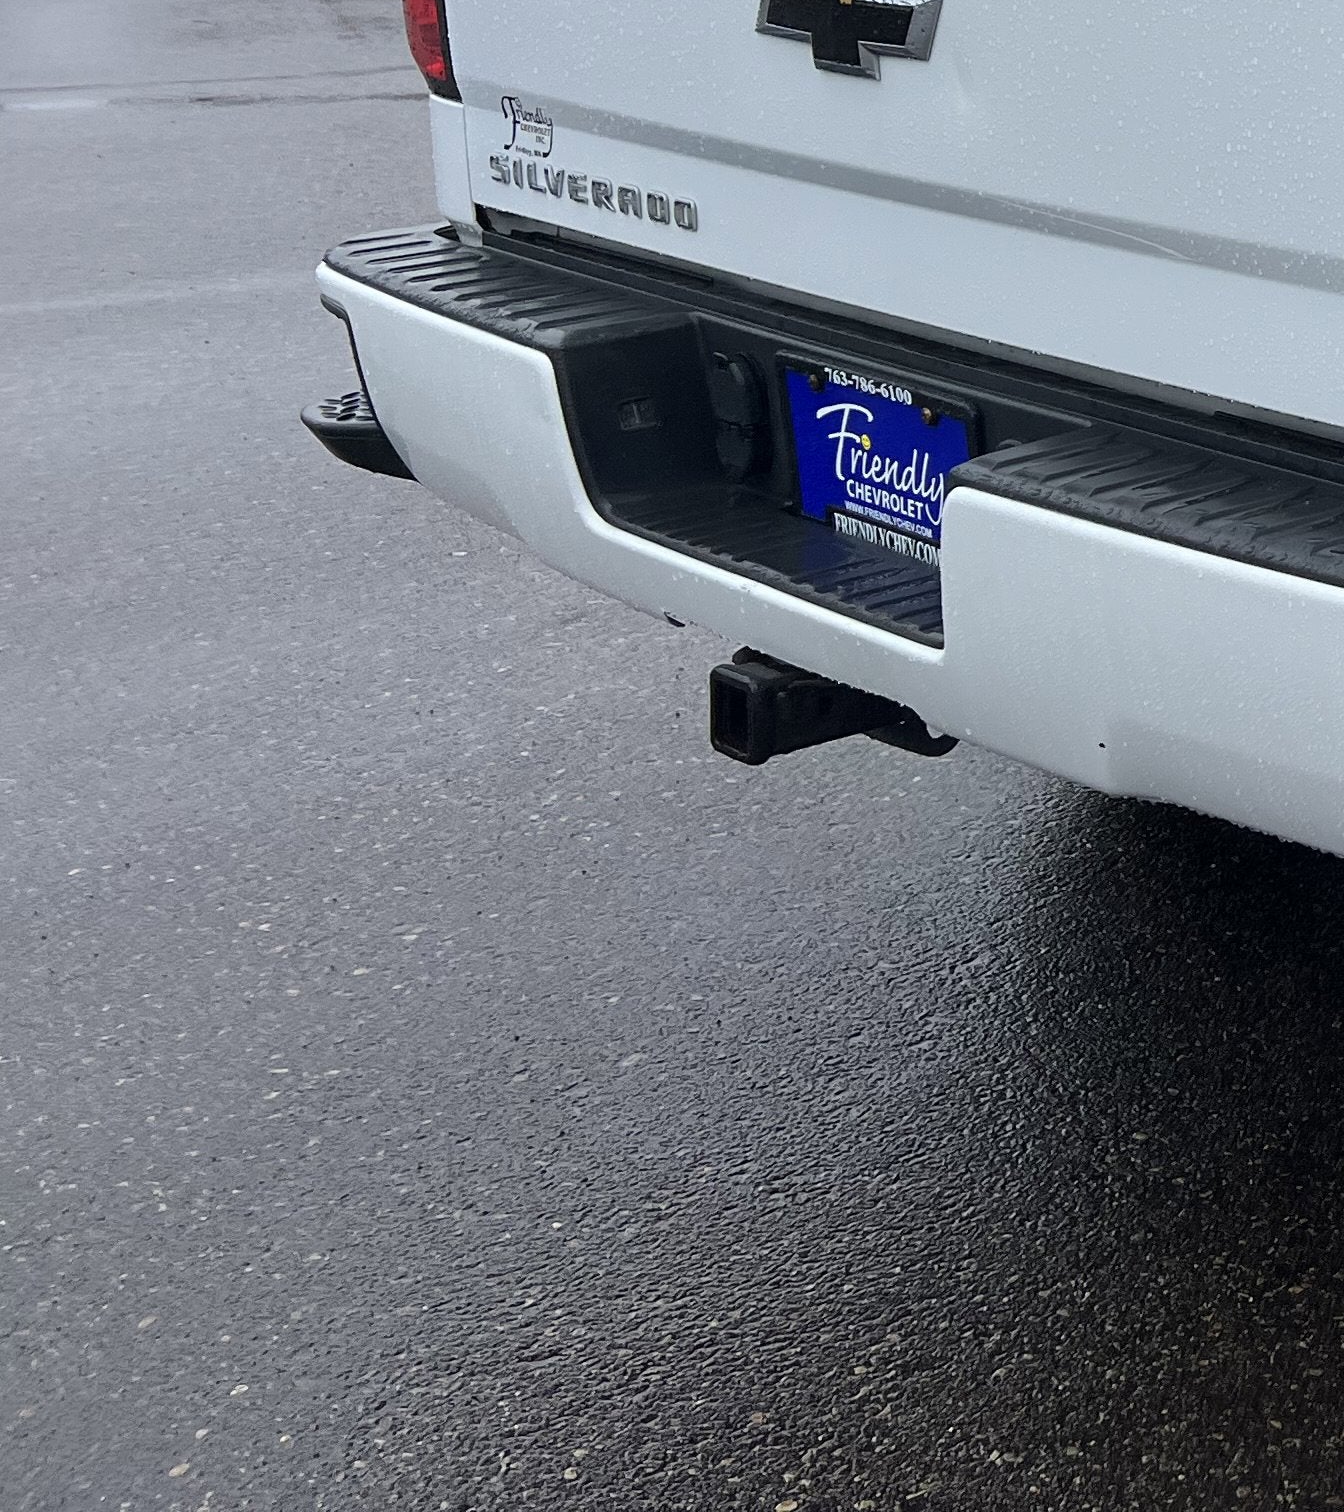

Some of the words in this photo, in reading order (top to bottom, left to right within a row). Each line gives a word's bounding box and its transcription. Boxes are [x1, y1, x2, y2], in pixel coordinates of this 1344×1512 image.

[489, 152, 699, 232] SILVERADO
[824, 366, 913, 406] 763-786-6100
[816, 402, 945, 526] Friendly
[844, 500, 934, 539] WWW.FRIENDLYCHEV.COM
[846, 479, 924, 521] CHEVROLET
